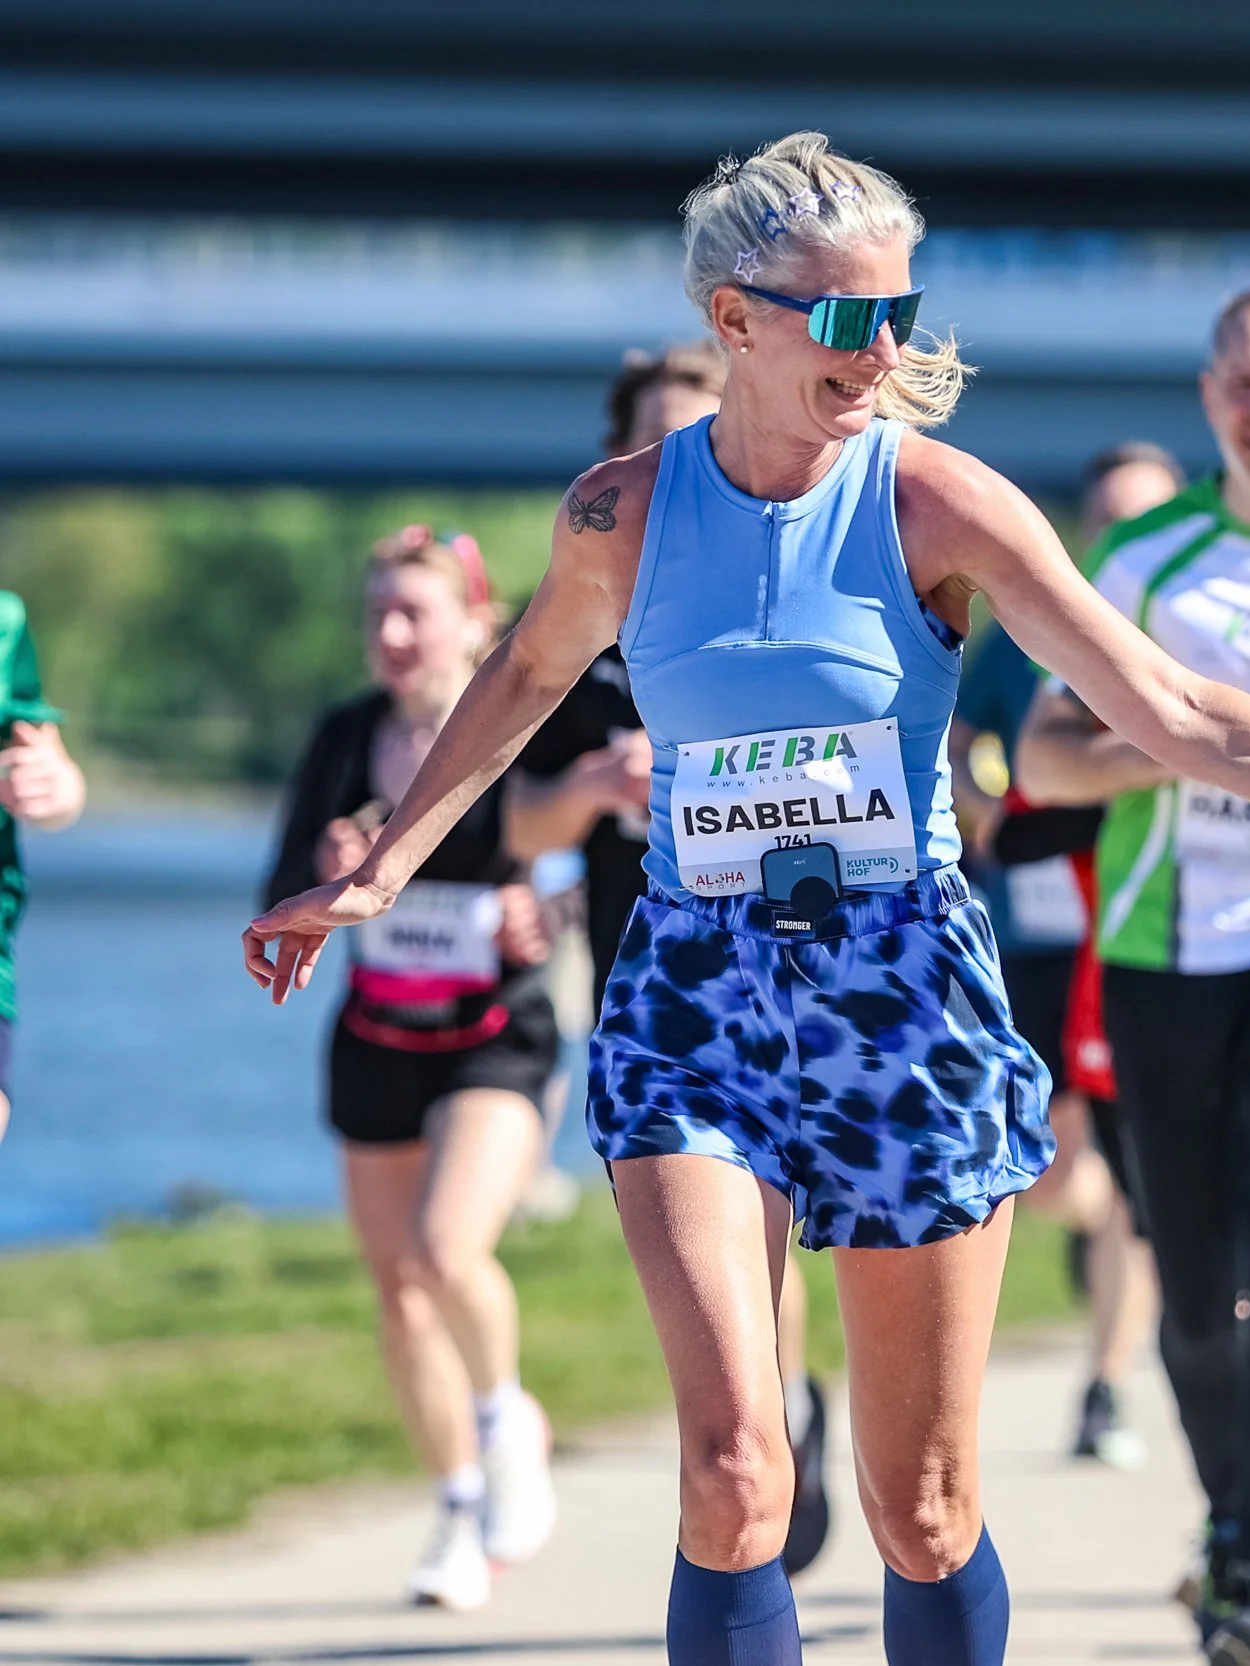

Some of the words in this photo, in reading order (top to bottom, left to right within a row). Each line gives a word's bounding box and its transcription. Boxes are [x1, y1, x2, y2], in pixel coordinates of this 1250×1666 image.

[709, 731, 857, 777] KEBA
[682, 788, 896, 836] ISABELLA
[774, 833, 812, 848] 1741
[846, 857, 888, 868] KULTUR
[847, 867, 870, 877] HOF
[696, 882, 746, 891] SPORT
[775, 919, 811, 931] STRONGER
